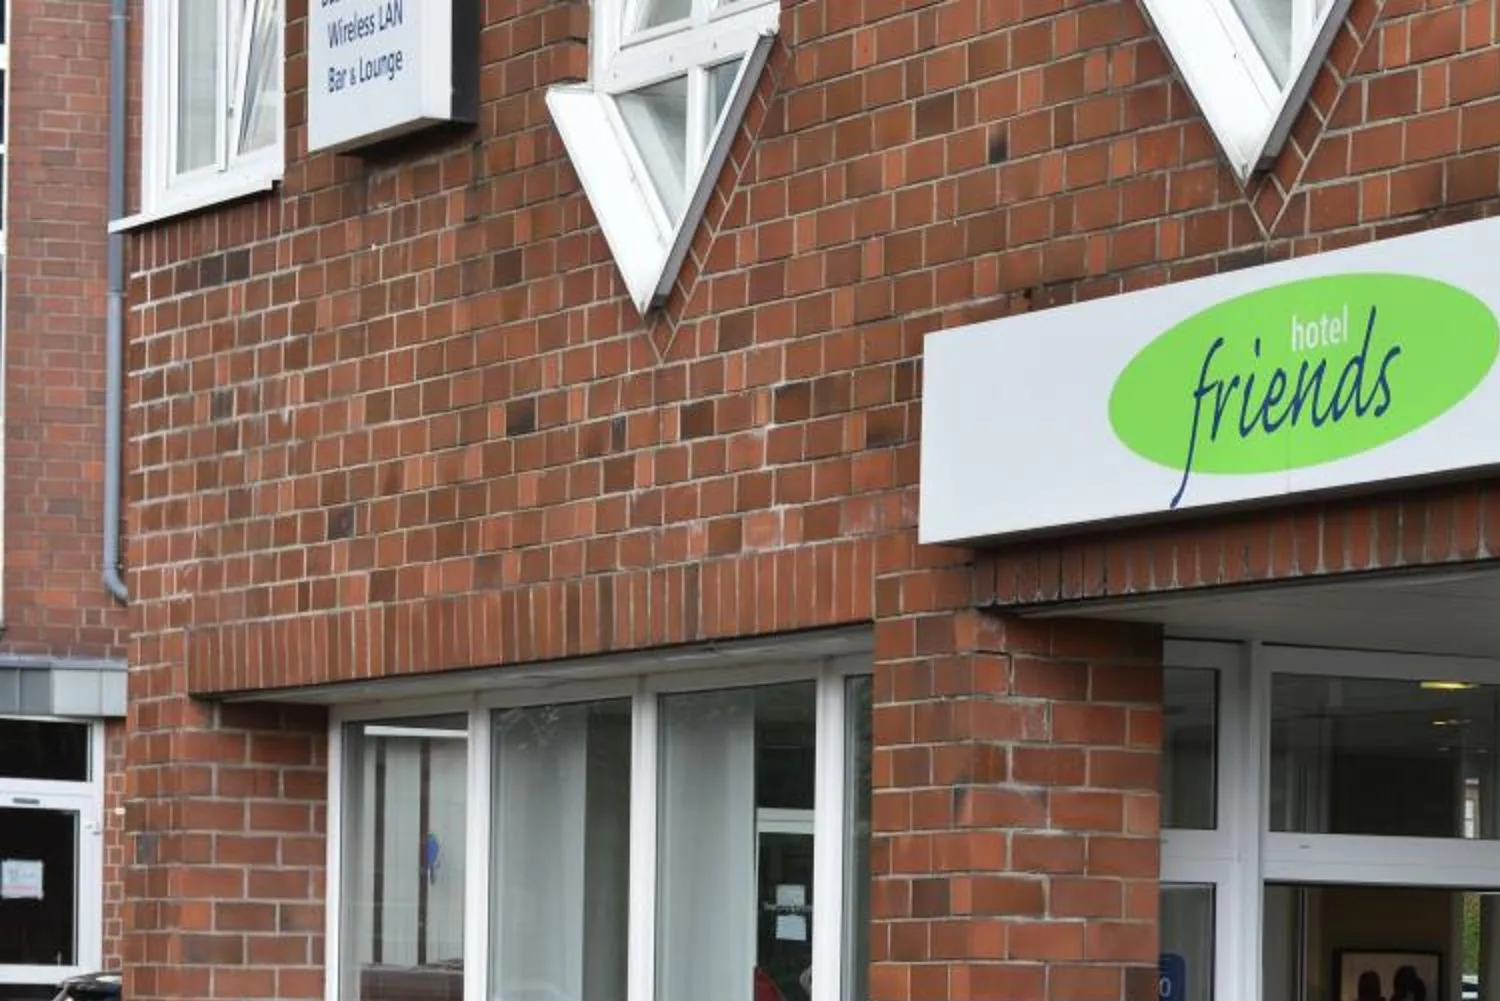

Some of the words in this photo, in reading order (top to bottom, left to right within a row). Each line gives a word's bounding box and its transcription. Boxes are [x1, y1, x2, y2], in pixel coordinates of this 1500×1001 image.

[328, 10, 375, 48] Wireless
[378, 0, 403, 31] LAN
[328, 66, 347, 92] Bar
[350, 67, 356, 85] &
[359, 50, 403, 82] Lounge
[1291, 304, 1348, 352] hotel
[1169, 305, 1402, 510] friends
